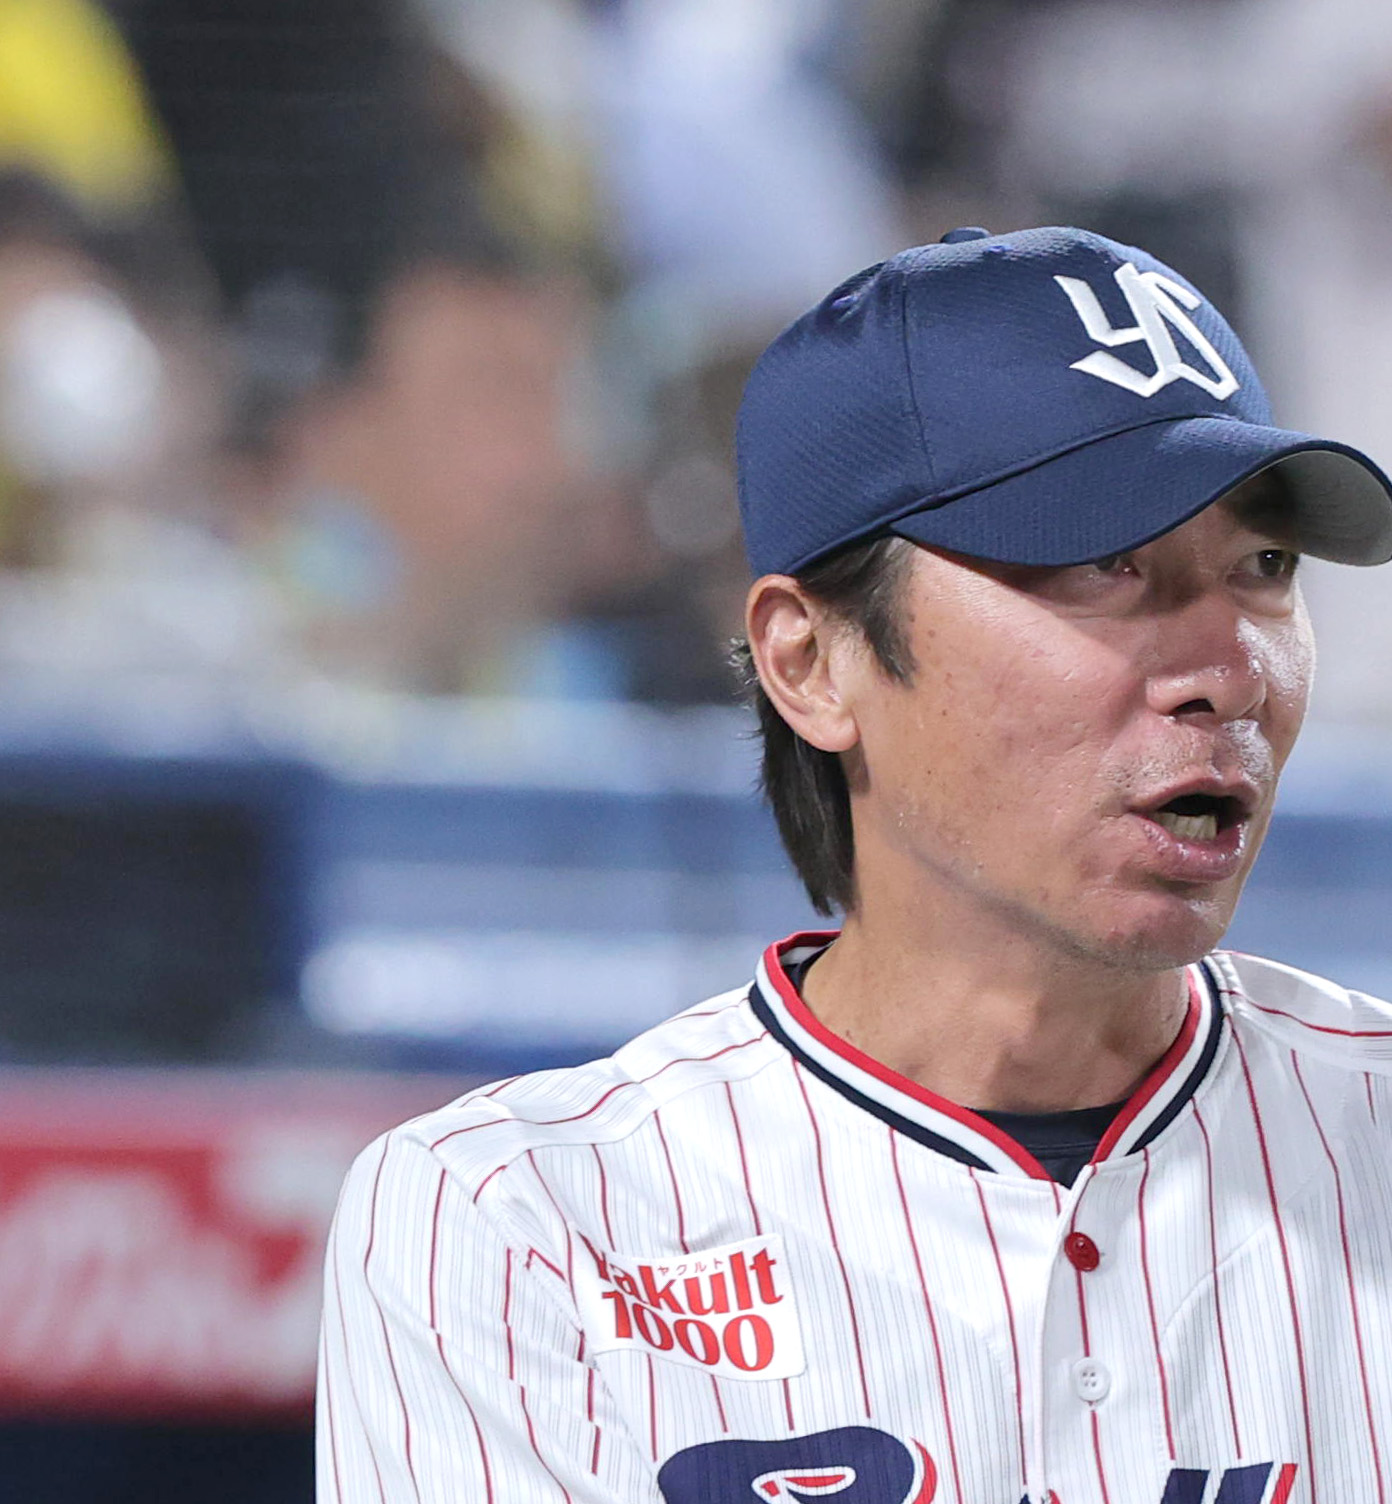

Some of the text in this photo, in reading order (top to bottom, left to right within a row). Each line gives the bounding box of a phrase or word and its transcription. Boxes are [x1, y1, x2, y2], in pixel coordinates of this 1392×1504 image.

[658, 1257, 724, 1277] ヤクルト
[601, 1290, 774, 1371] 1000
